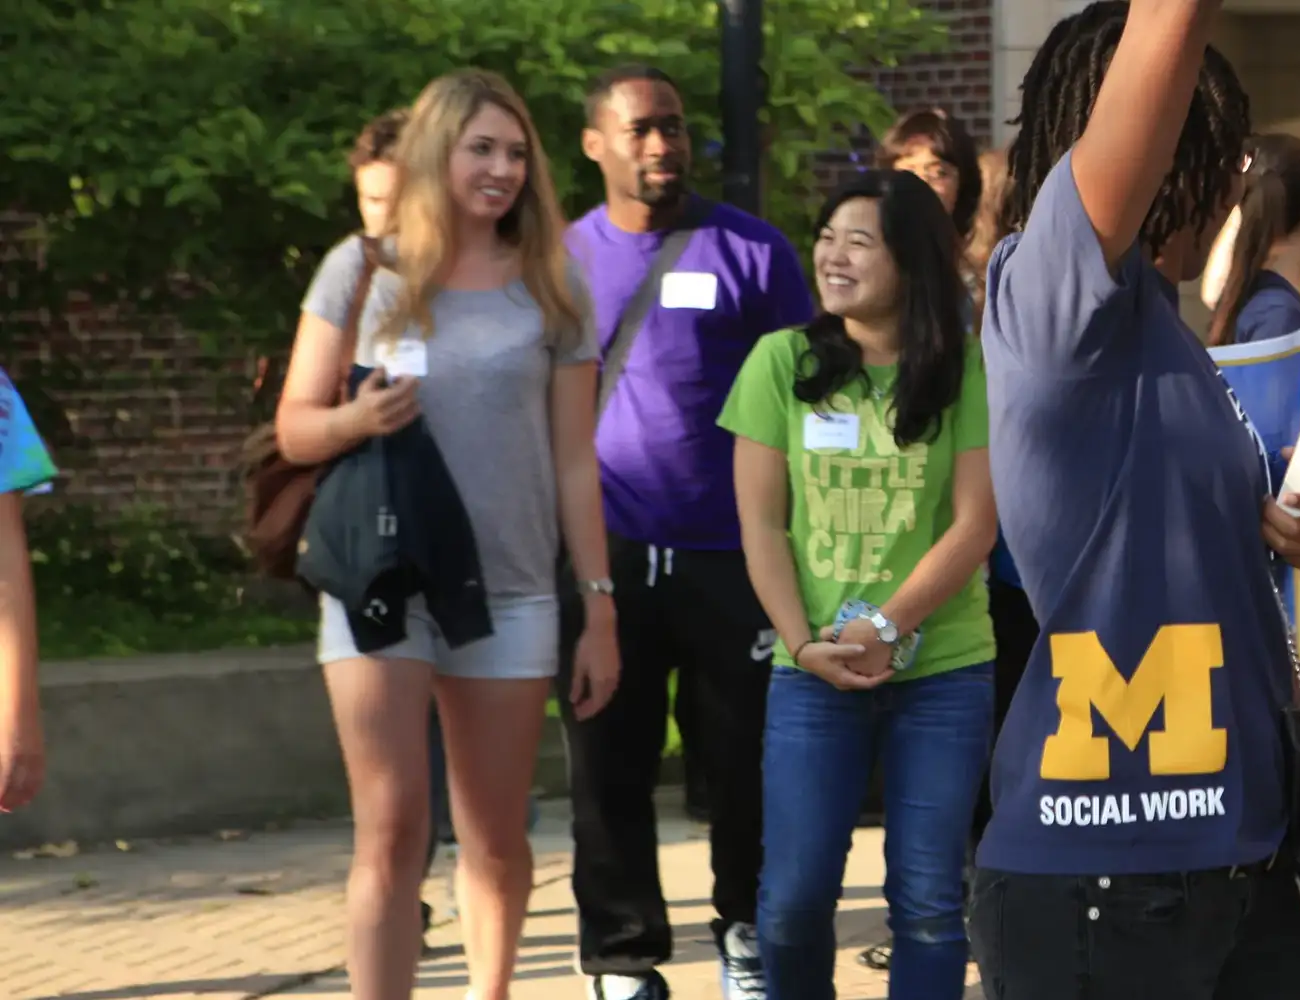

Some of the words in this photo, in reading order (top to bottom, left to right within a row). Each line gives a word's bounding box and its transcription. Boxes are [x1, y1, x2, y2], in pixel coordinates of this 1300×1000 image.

[803, 454, 927, 488] LITTLE
[806, 486, 916, 533] MIRA
[807, 529, 893, 583] CLE.
[1040, 623, 1227, 780] M
[1040, 794, 1137, 826] SOCIAL
[1140, 787, 1225, 821] WORK
